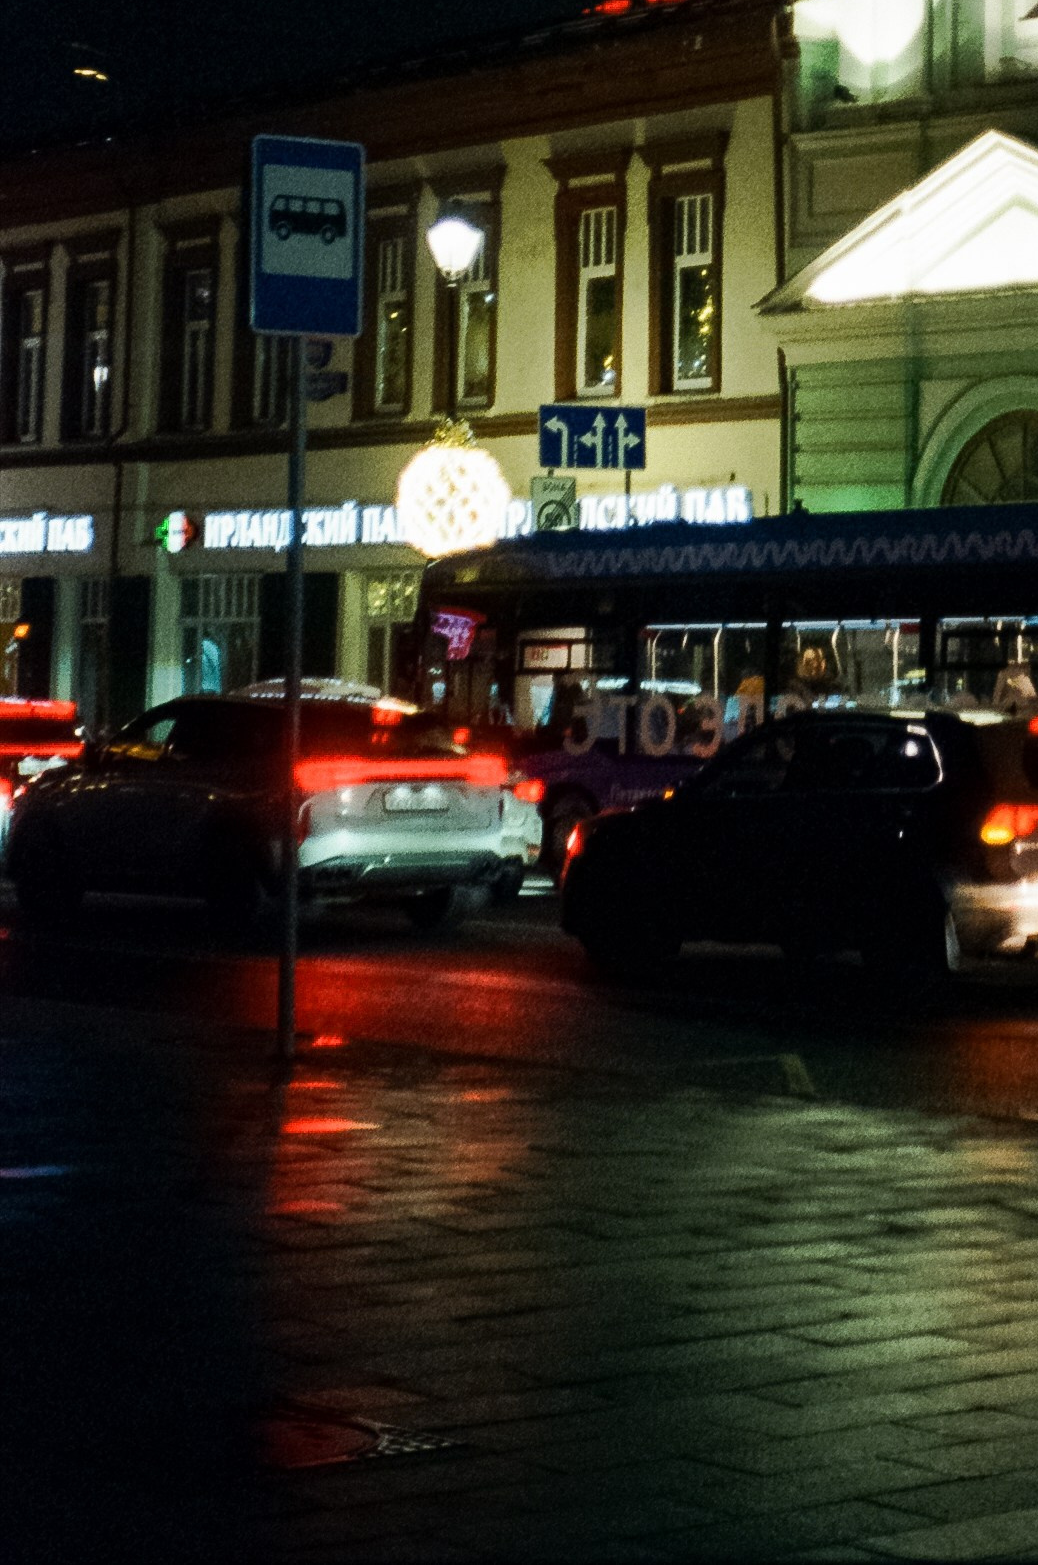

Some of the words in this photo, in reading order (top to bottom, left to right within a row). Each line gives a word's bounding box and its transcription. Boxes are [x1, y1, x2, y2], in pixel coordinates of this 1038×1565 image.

[683, 486, 752, 525] ПАБ
[47, 515, 93, 552] ПАБ
[203, 500, 359, 553] ИРЛАНДКИЙ
